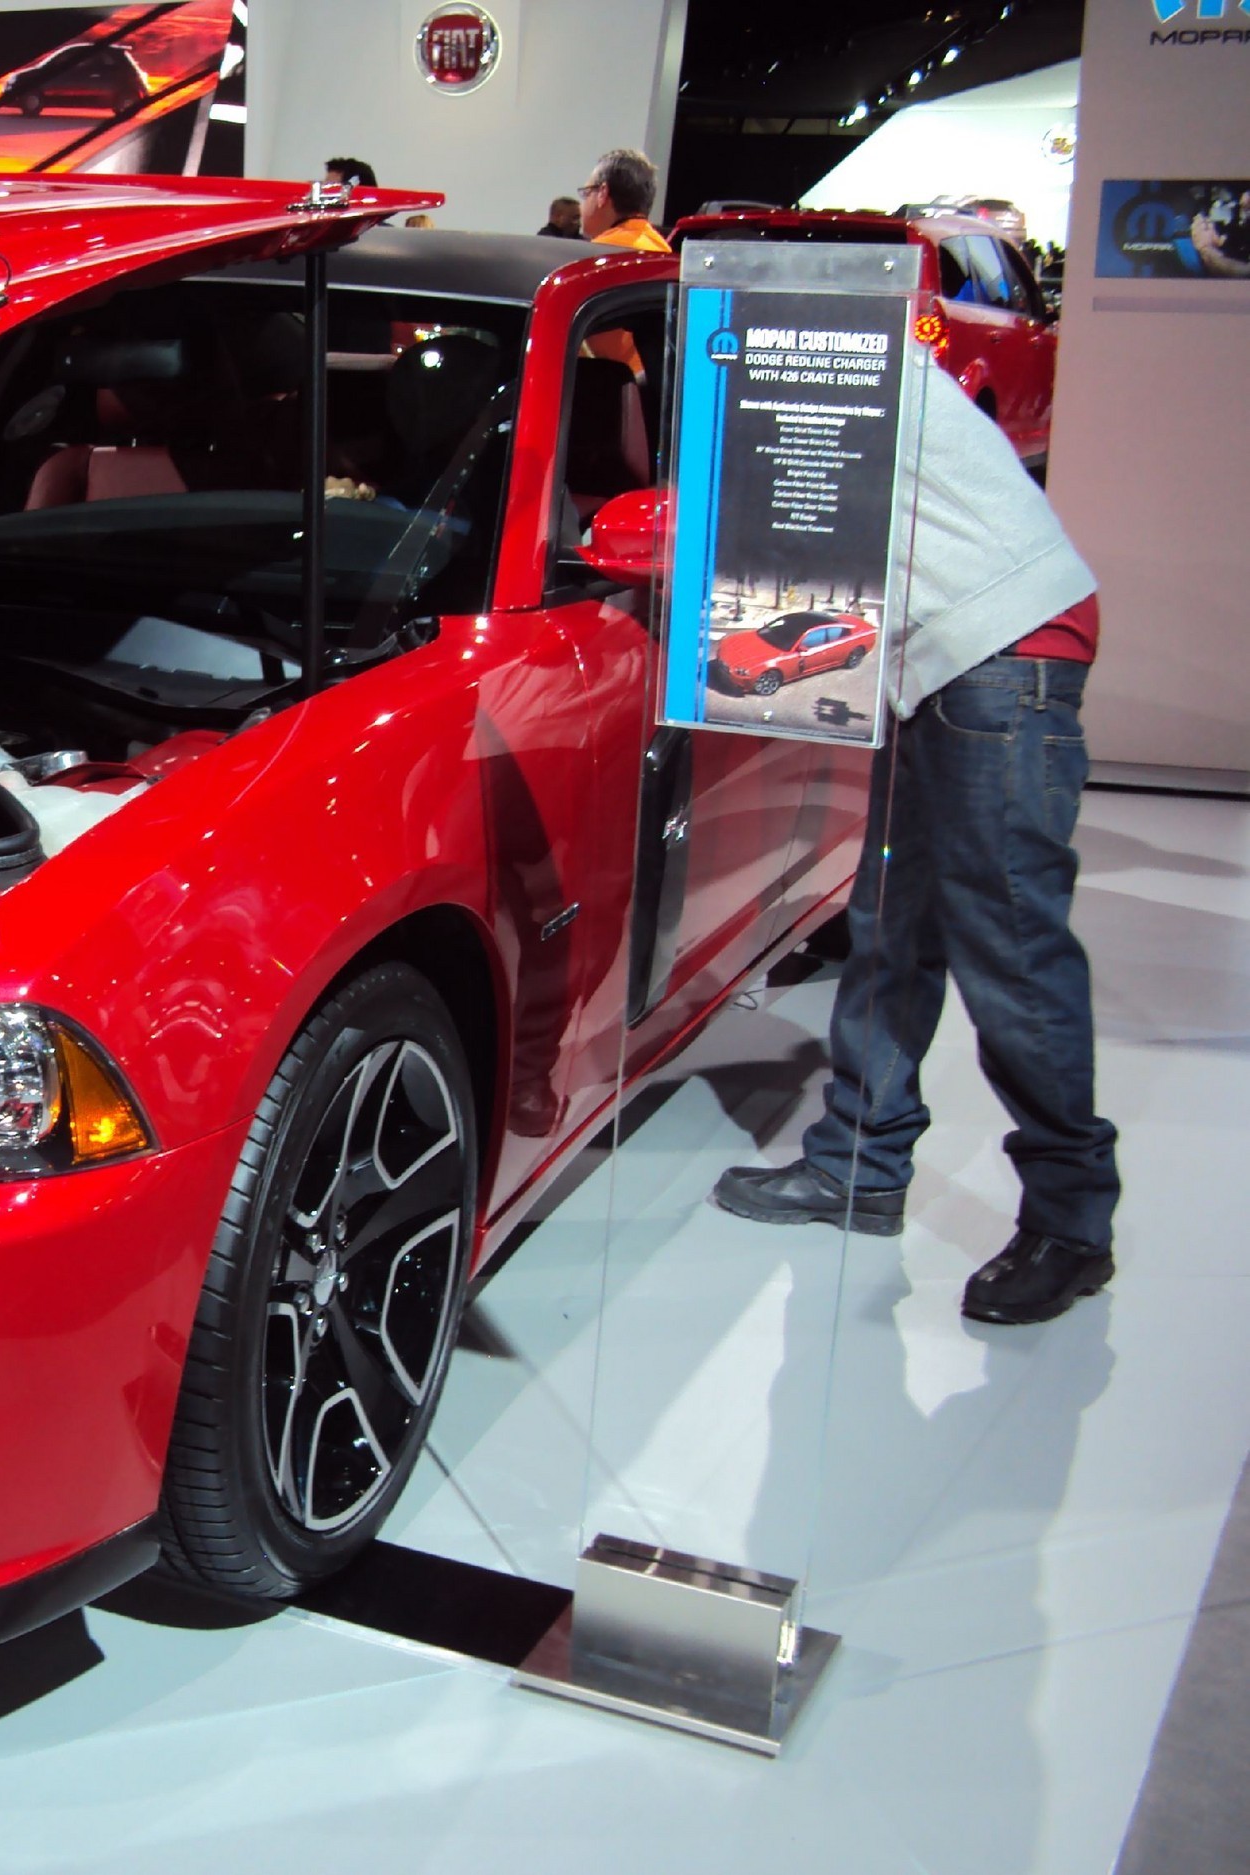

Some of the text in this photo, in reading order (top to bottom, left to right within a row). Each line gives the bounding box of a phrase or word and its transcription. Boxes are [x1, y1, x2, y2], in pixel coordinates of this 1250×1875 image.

[431, 28, 480, 69] FIAT
[746, 328, 888, 354] MOPAR CUSTOMIZED
[745, 353, 784, 366] DODGE
[785, 355, 831, 369] REDLINE
[832, 357, 886, 371] CHARGER
[749, 369, 779, 380] WITH
[800, 371, 835, 384] CRATE
[837, 374, 881, 387] ENGINE
